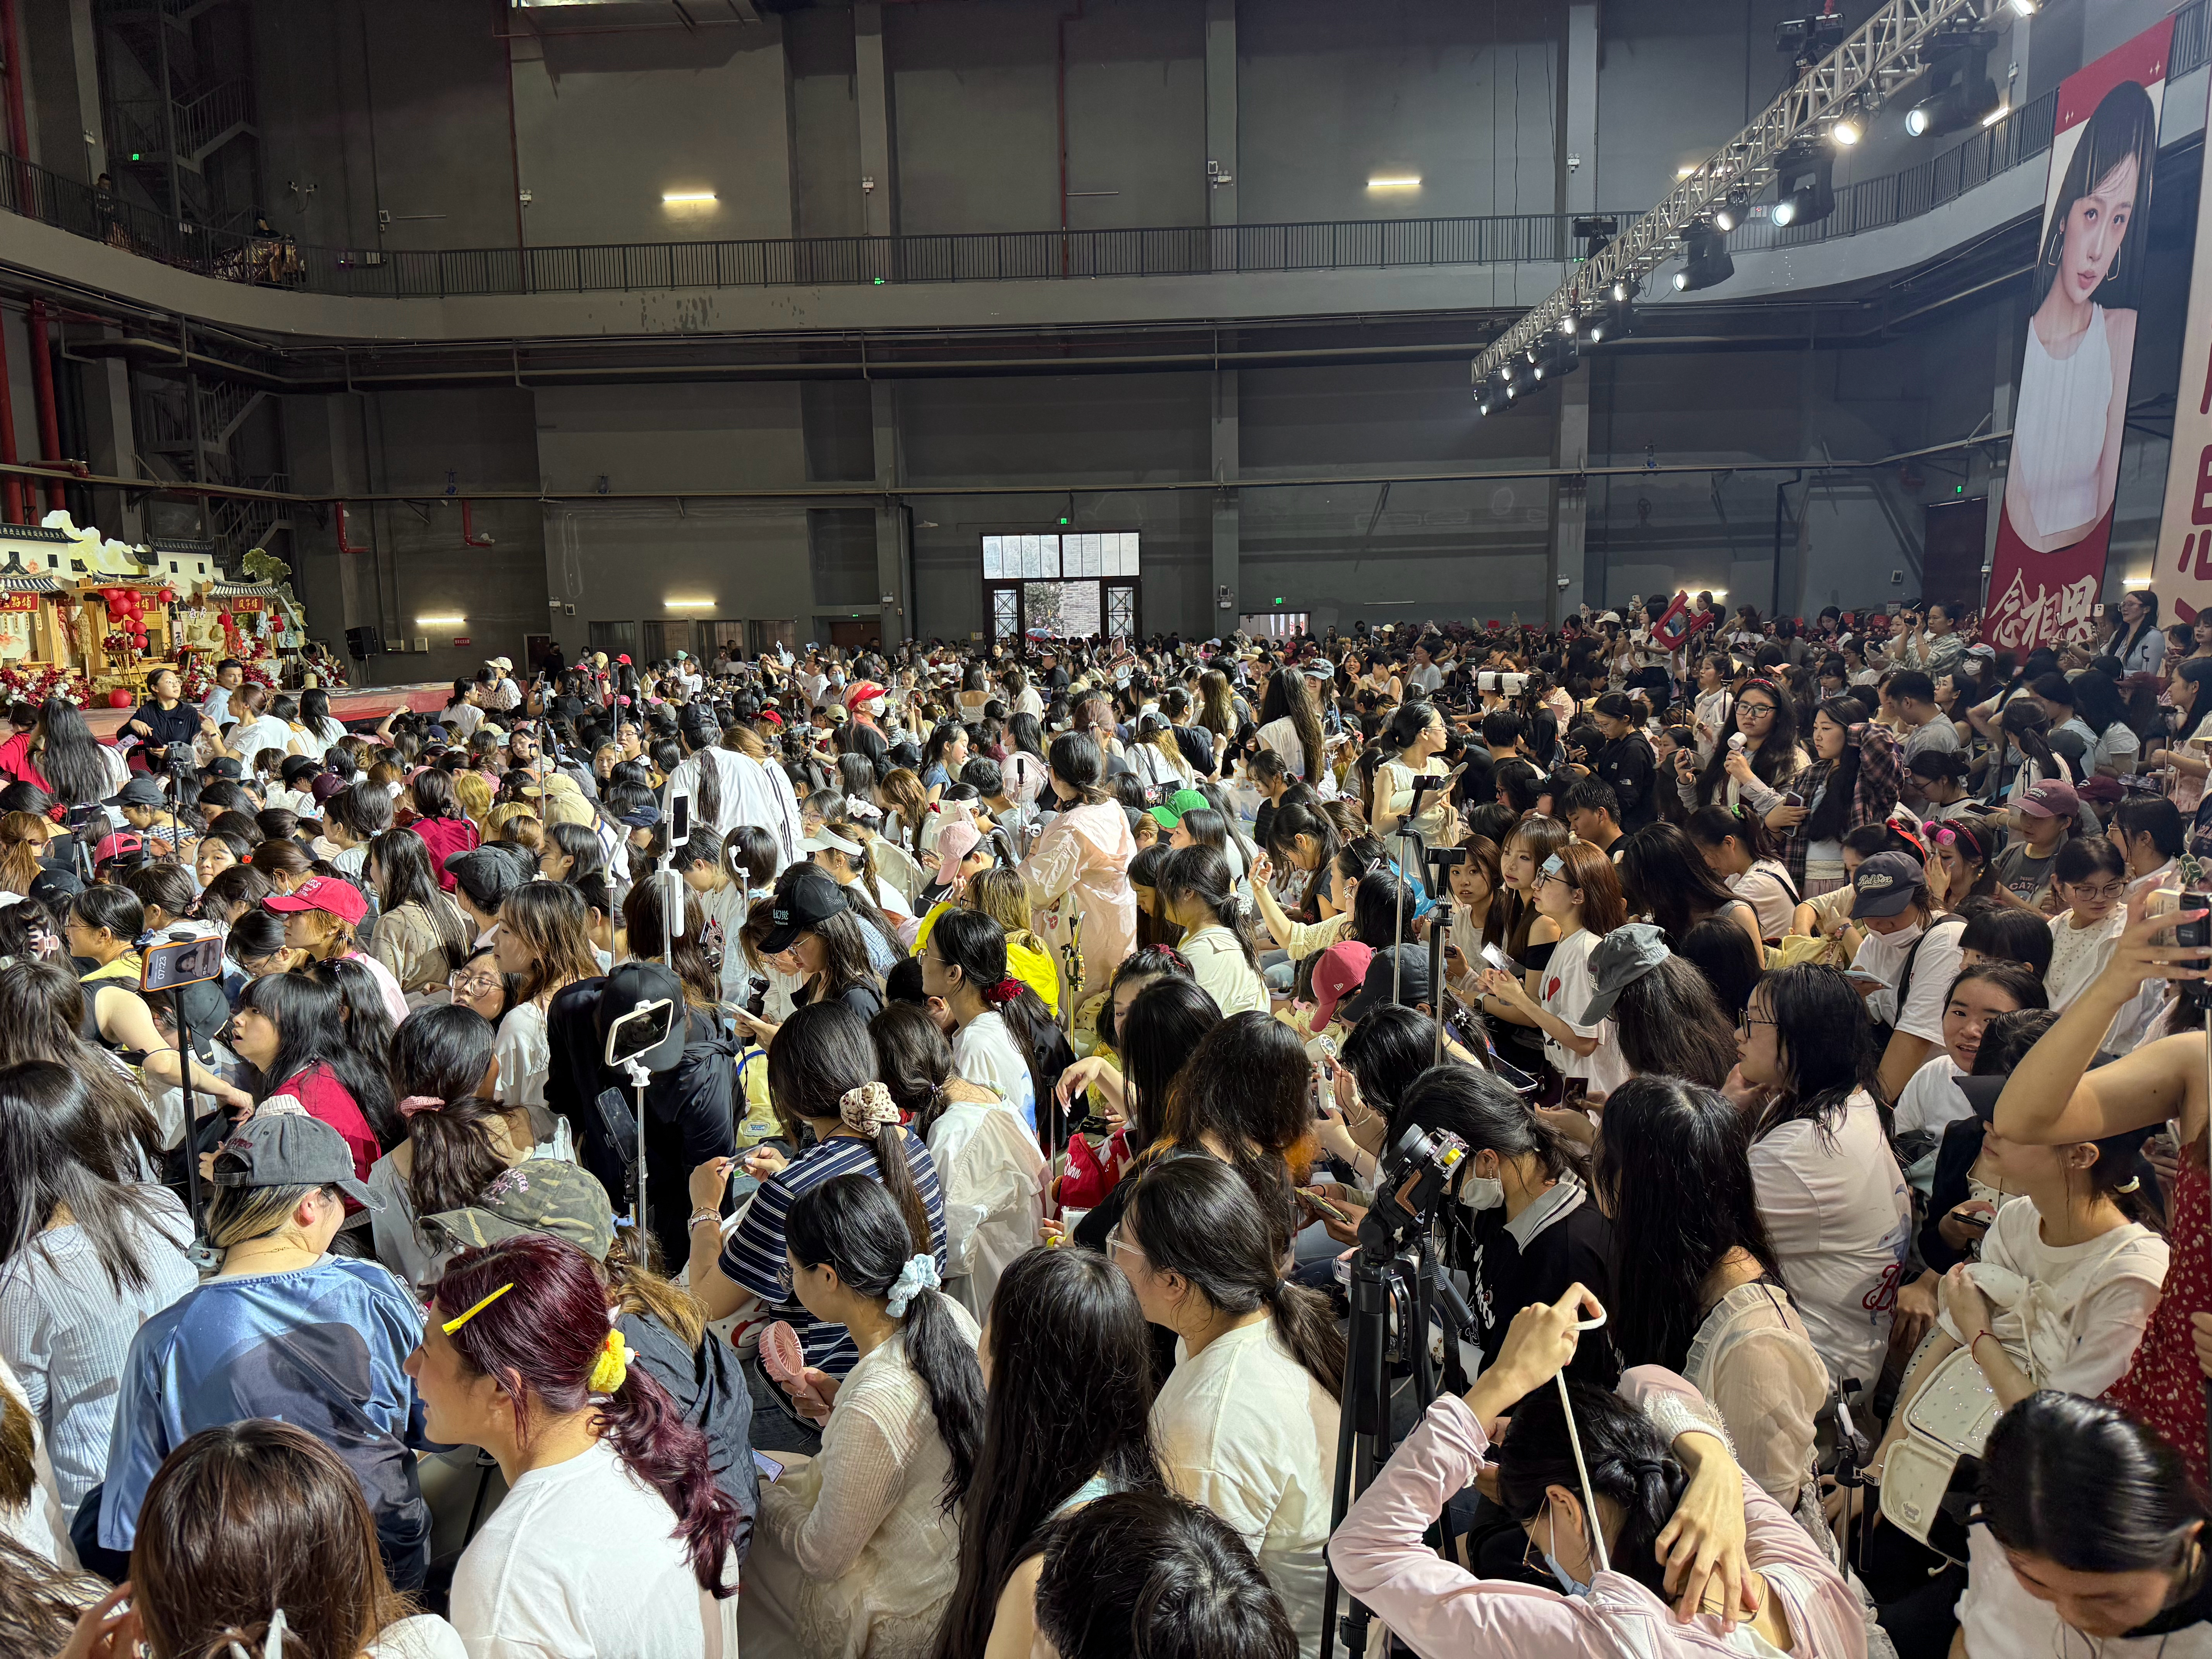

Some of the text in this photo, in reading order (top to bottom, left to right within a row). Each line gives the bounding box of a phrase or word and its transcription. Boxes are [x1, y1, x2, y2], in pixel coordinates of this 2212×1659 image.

[4, 595, 32, 610] 點鋪
[1857, 874, 1893, 887] Red Sox
[157, 956, 167, 980] 07:23
